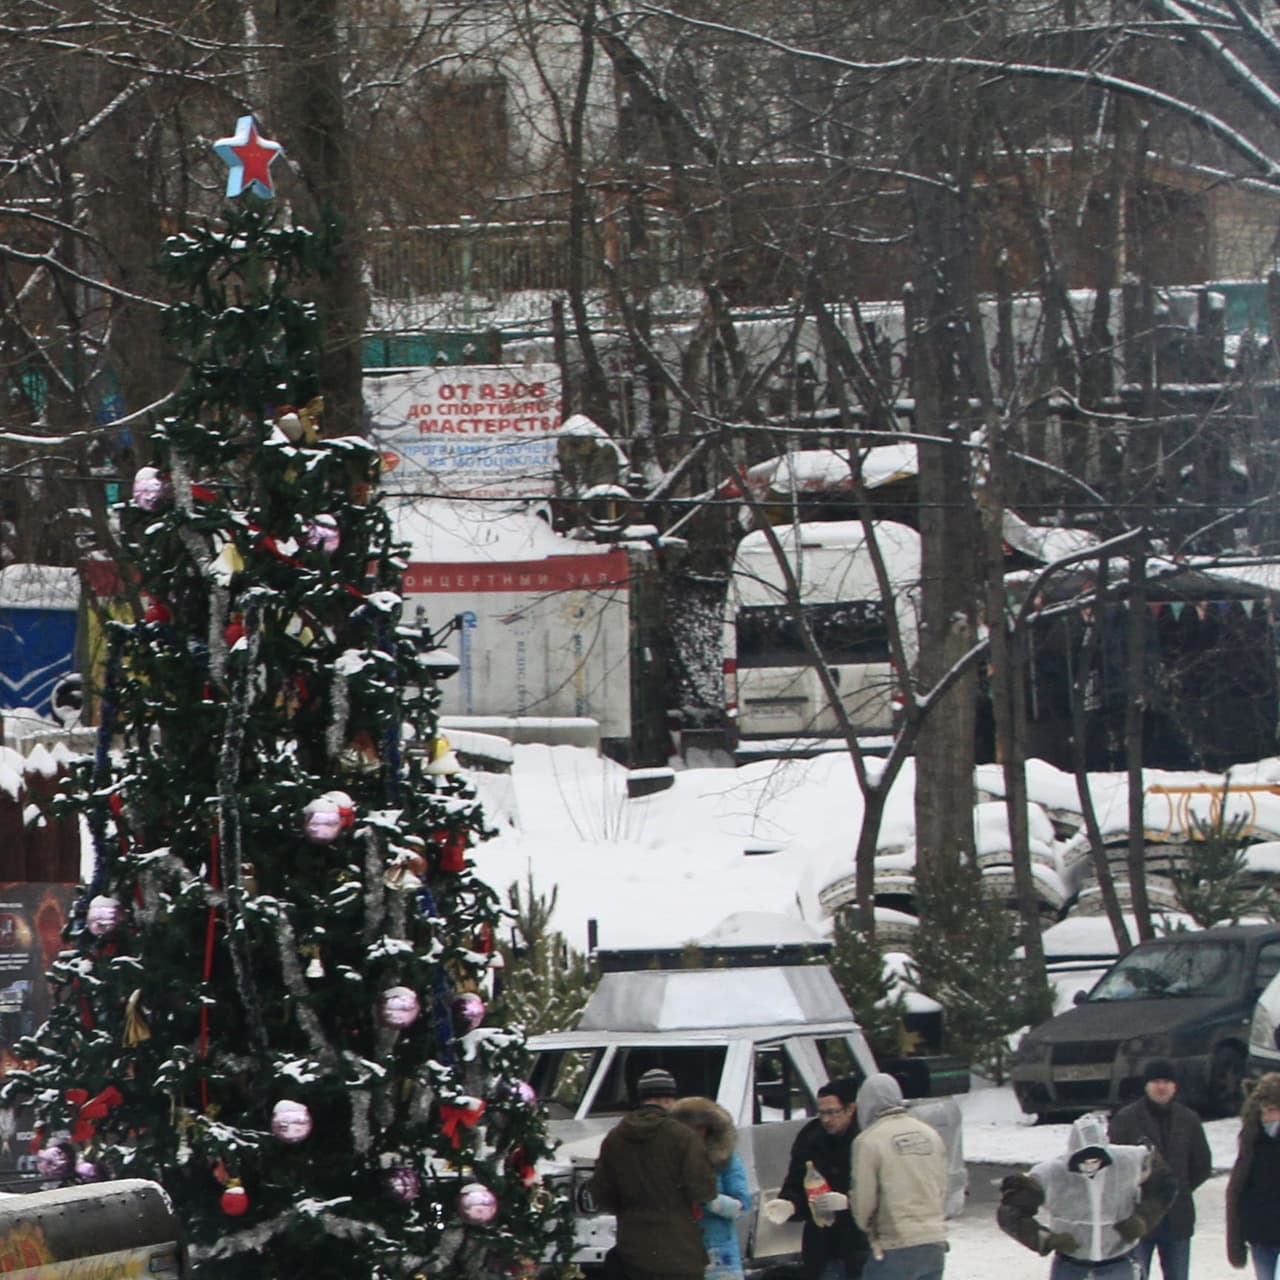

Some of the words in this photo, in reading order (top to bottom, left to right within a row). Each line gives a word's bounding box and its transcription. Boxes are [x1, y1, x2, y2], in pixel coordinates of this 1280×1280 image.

[438, 384, 472, 400] ОТ
[479, 382, 545, 400] АЗОВ
[407, 403, 432, 418] ДО
